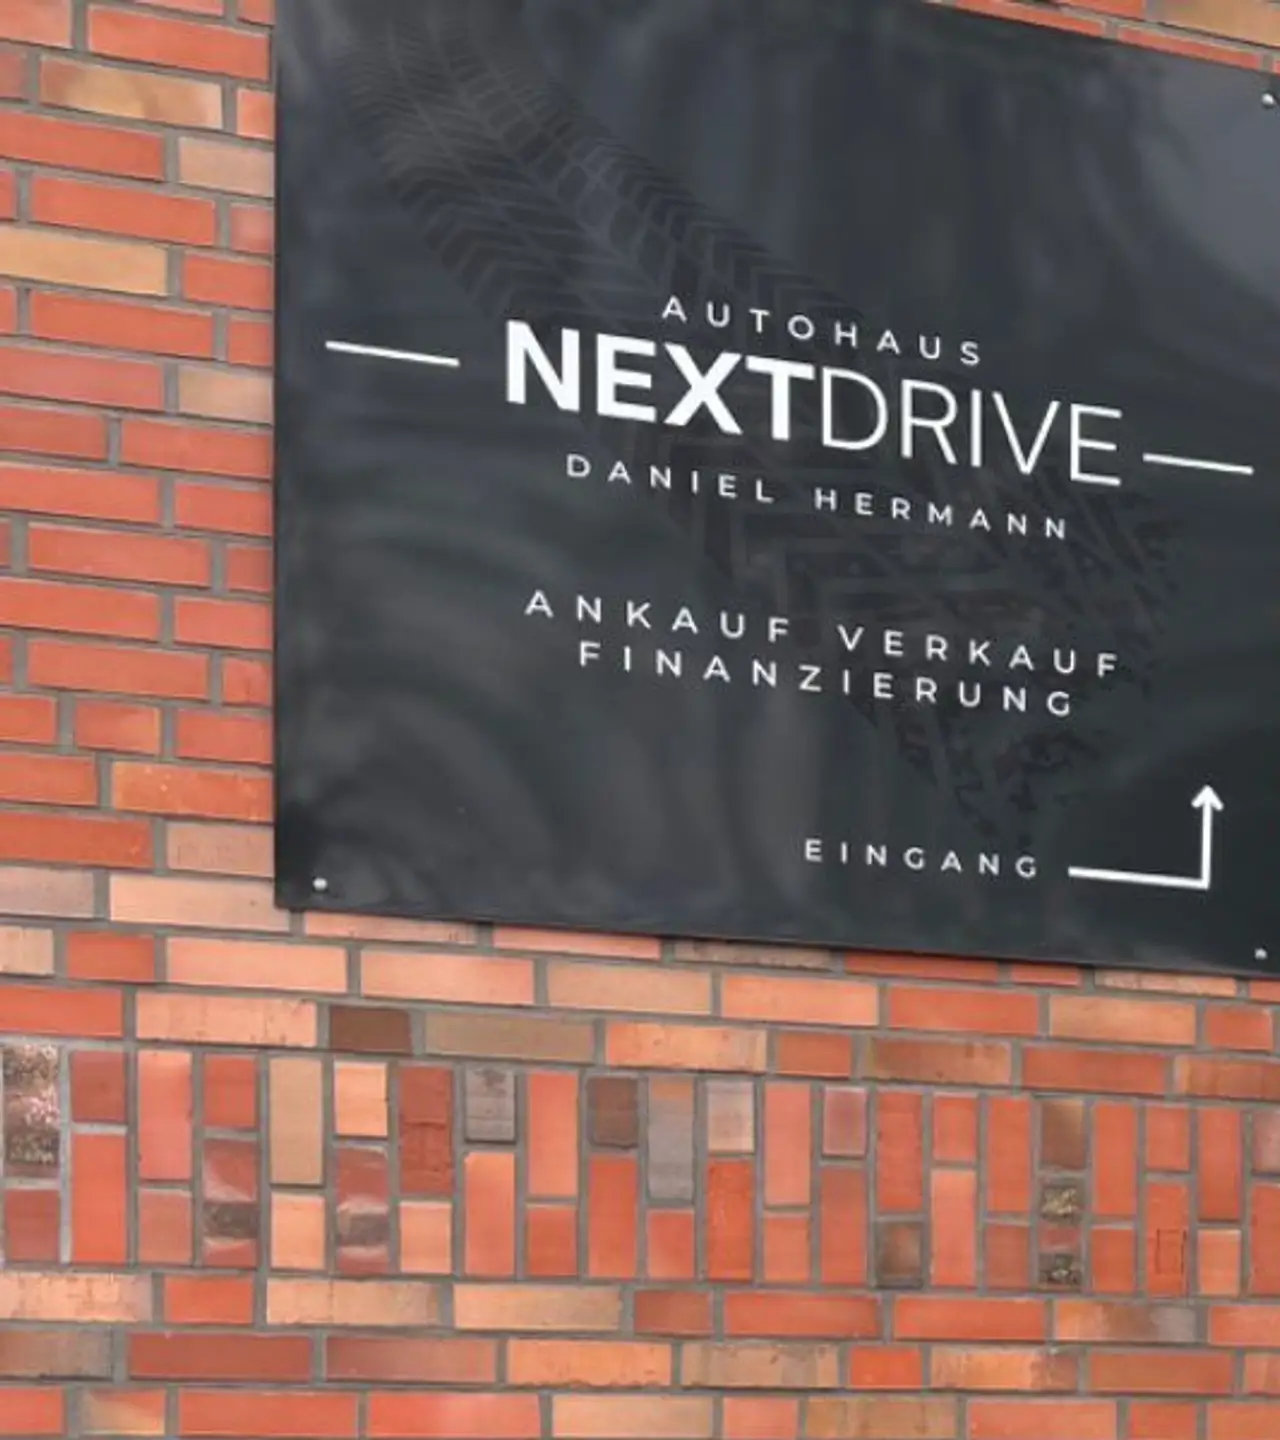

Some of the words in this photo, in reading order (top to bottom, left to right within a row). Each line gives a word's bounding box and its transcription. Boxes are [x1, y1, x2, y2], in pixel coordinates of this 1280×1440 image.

[661, 296, 981, 366] AUTOHAUS
[506, 319, 1123, 487] NEXTDRIVE
[566, 453, 773, 503] DANIEL
[815, 488, 1066, 540] HERMANN
[524, 590, 790, 643] ANKAUF
[837, 625, 1117, 678] VERKAUF
[579, 640, 1071, 718] FINANZIERUNG
[805, 839, 1037, 878] EINGANG
